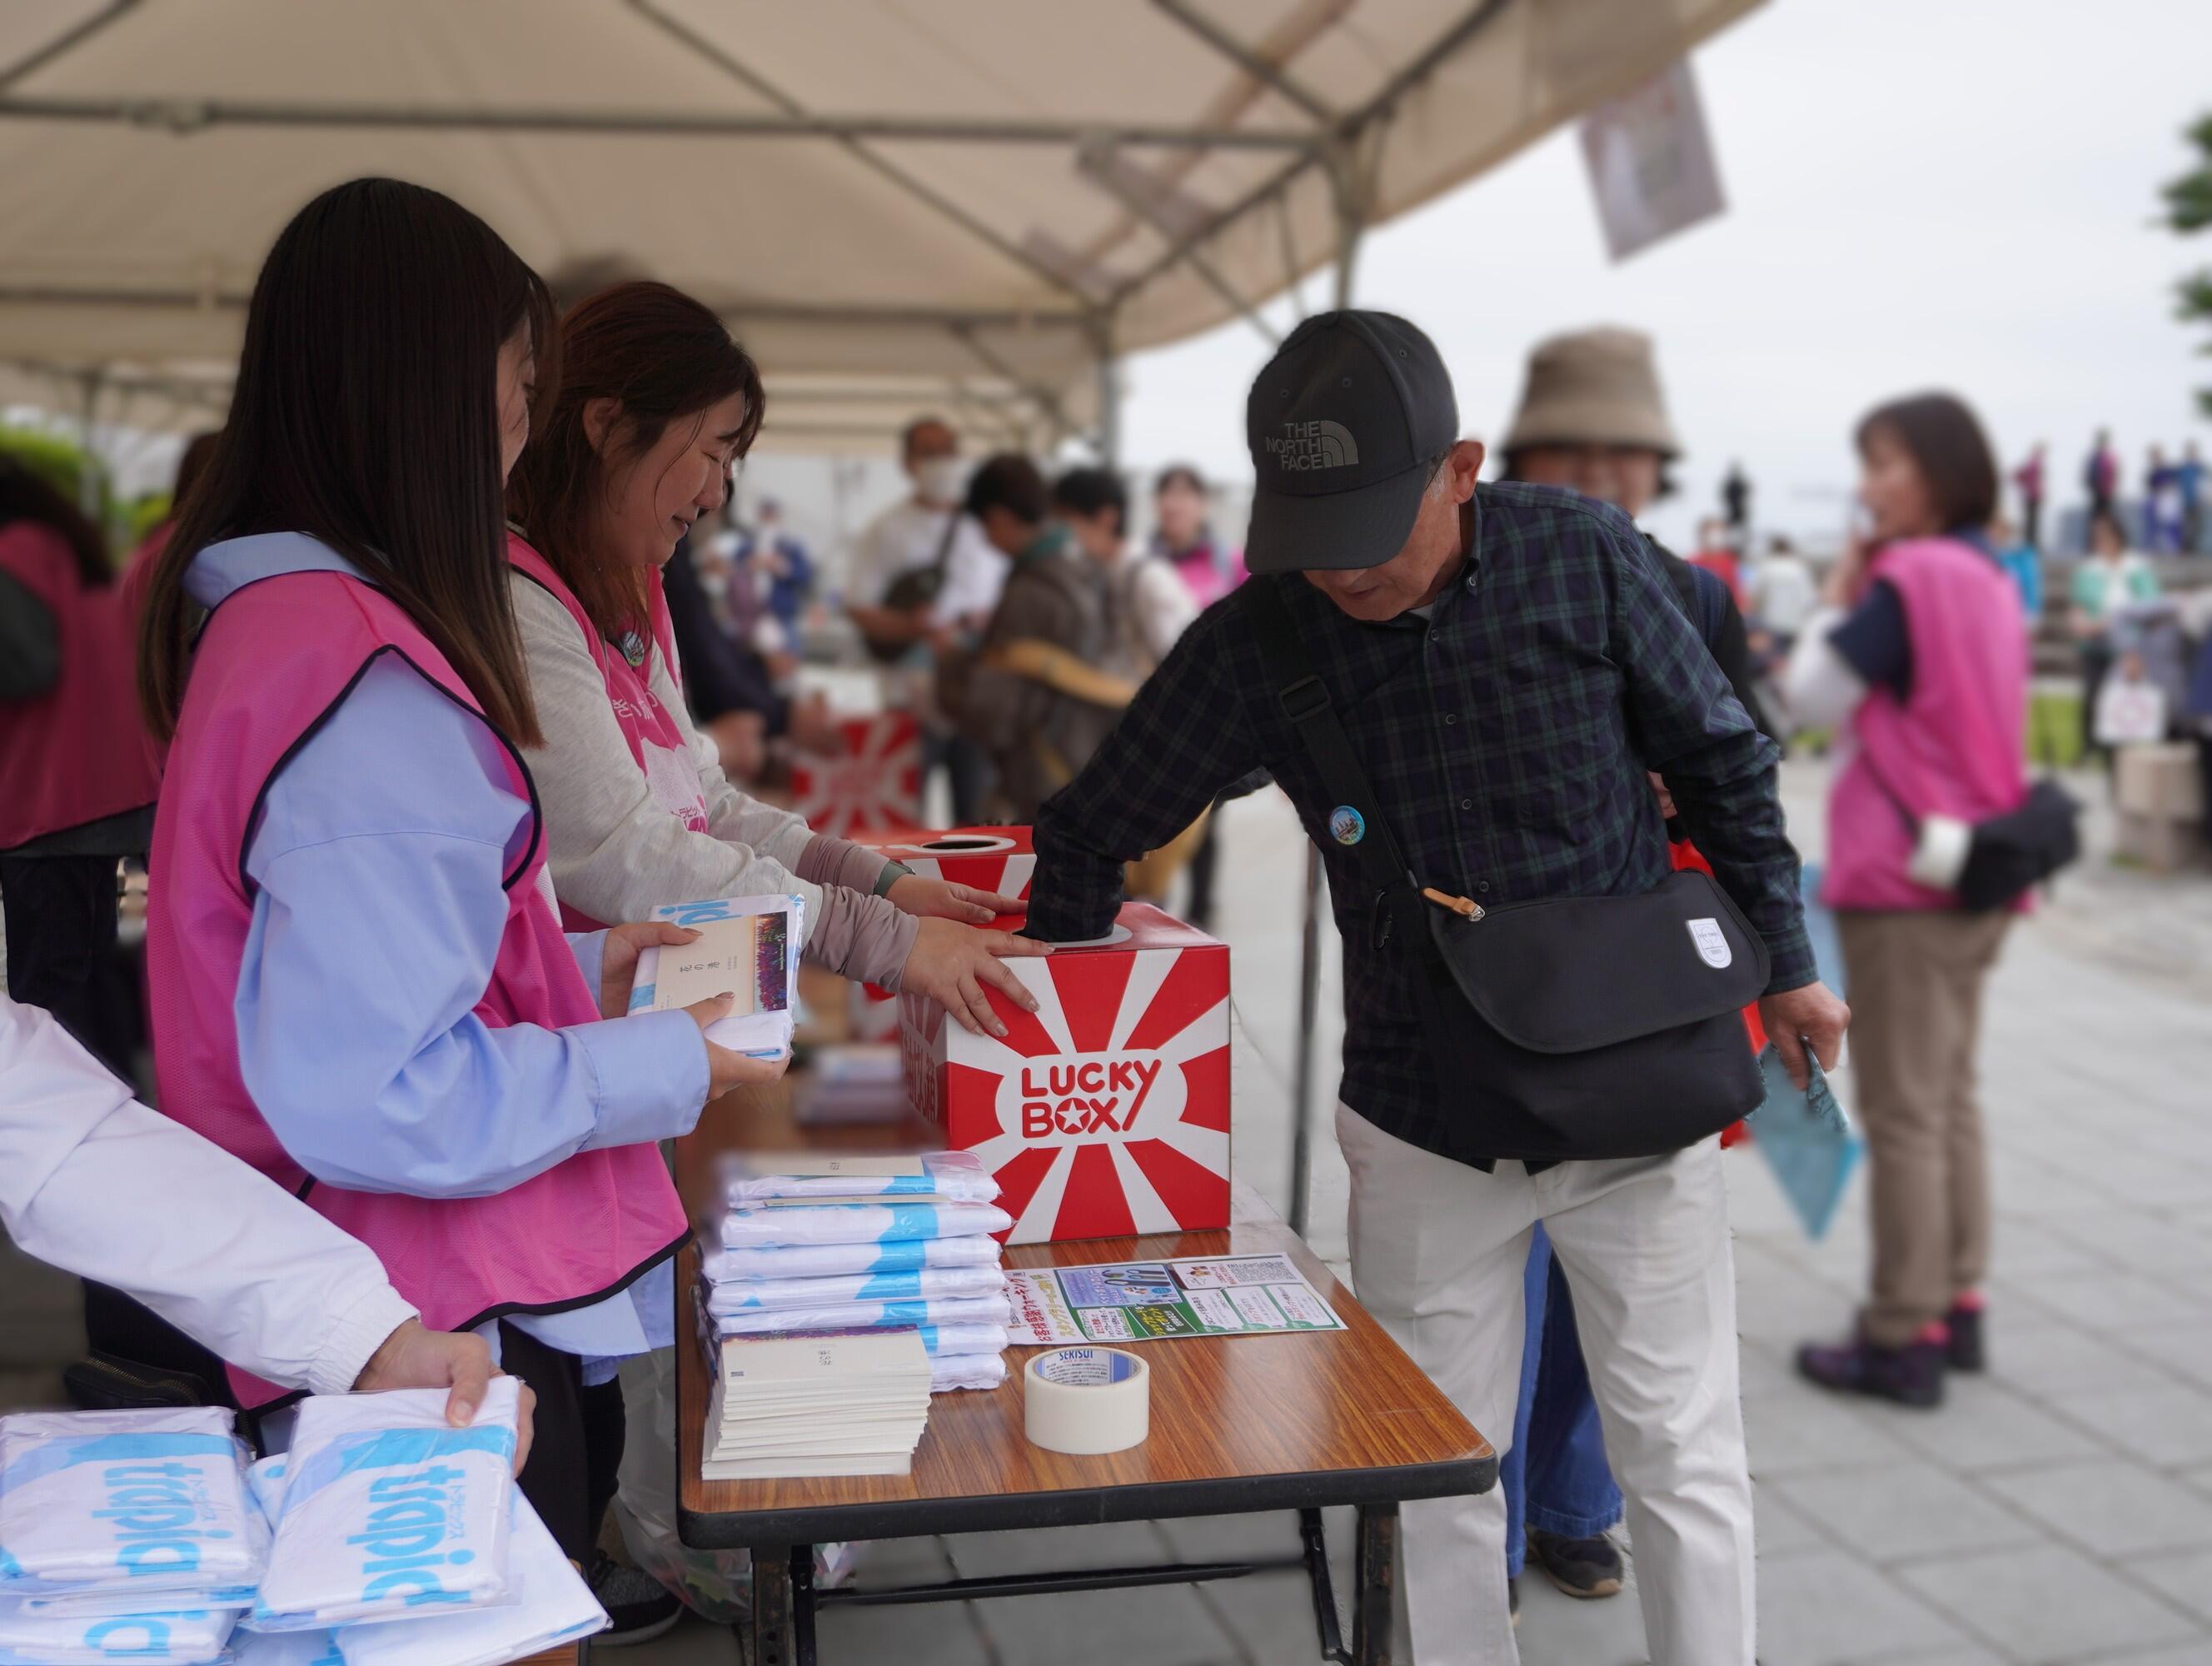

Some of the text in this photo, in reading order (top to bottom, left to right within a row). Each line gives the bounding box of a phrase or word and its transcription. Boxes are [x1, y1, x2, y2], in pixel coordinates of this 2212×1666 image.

[1265, 436, 1322, 455] NORTH
[1284, 420, 1320, 438] THE
[1280, 452, 1323, 471] FACE
[1022, 1059, 1162, 1131] LUCKY
[1022, 1097, 1121, 1139] BOX
[1059, 1349, 1094, 1361] SEKISUI
[92, 1463, 234, 1576] trapic
[448, 1485, 466, 1539] トラピックス
[346, 1465, 476, 1606] trapic
